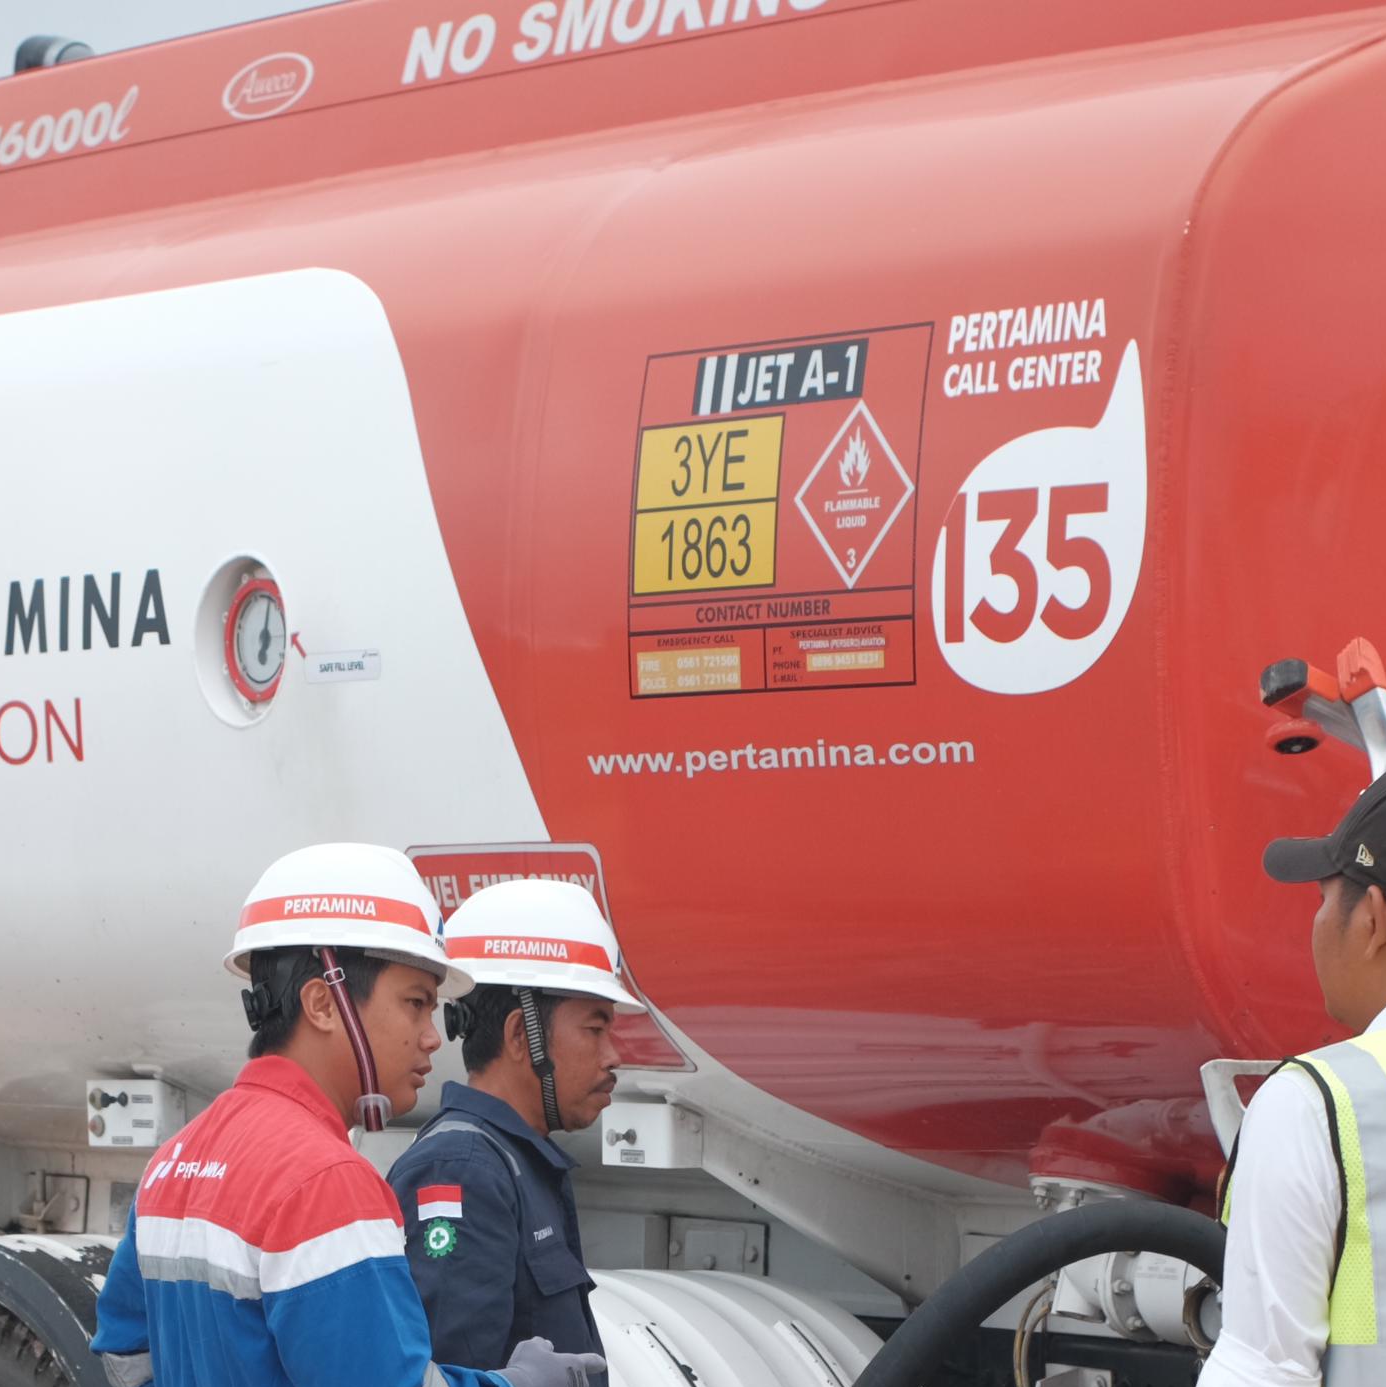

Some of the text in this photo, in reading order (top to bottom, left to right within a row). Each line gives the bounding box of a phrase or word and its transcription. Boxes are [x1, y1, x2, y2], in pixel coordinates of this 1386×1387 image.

[401, 13, 497, 84] NO
[946, 298, 1108, 354] PERTAMINA
[737, 345, 859, 406] JET A-1
[943, 351, 1102, 398] CALL CENTER
[671, 427, 751, 498] 3YE
[824, 496, 881, 513] FLAMMABLE
[836, 515, 867, 529] LIQUID
[660, 513, 753, 584] 1863
[846, 548, 857, 569] 3
[944, 481, 1110, 645] 135
[695, 599, 832, 625] CONTACT NUMBER
[790, 624, 884, 640] SPECIALIST ADVICE
[347, 660, 365, 672] LEVEL
[587, 739, 976, 779] www.pertamina.com
[284, 897, 377, 917] PERTAMINA
[420, 874, 466, 909] UEL
[483, 939, 568, 959] PERTAMINA
